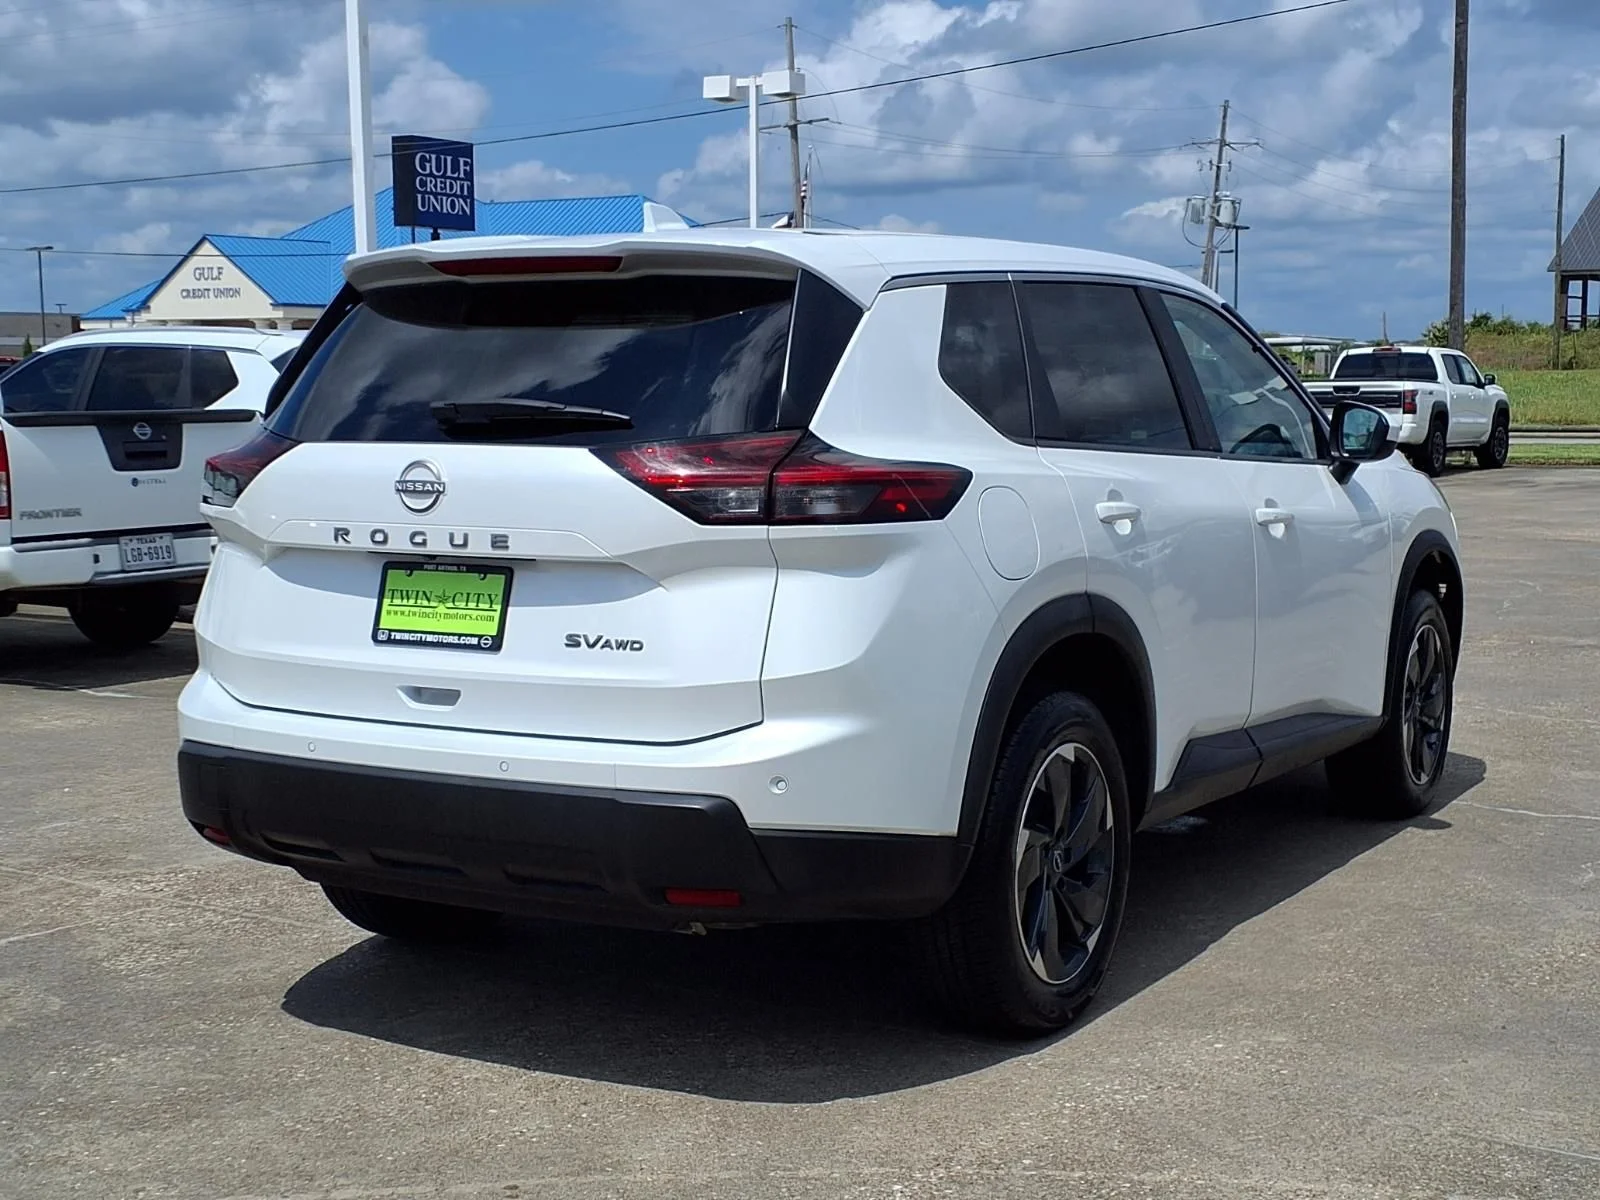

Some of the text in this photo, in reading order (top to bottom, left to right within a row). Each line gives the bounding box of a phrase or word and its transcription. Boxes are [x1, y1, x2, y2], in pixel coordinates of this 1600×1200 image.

[415, 152, 471, 178] GULF
[416, 176, 471, 195] CREDIT
[416, 194, 470, 216] UNION
[193, 266, 223, 281] GULF
[180, 288, 241, 299] CREDIT UNION
[395, 481, 445, 492] NISSAN
[20, 508, 82, 520] FRONTIER
[333, 527, 510, 550] ROGUE
[388, 588, 499, 608] TWIN CITY
[385, 609, 495, 622] www.twincitymotors.com
